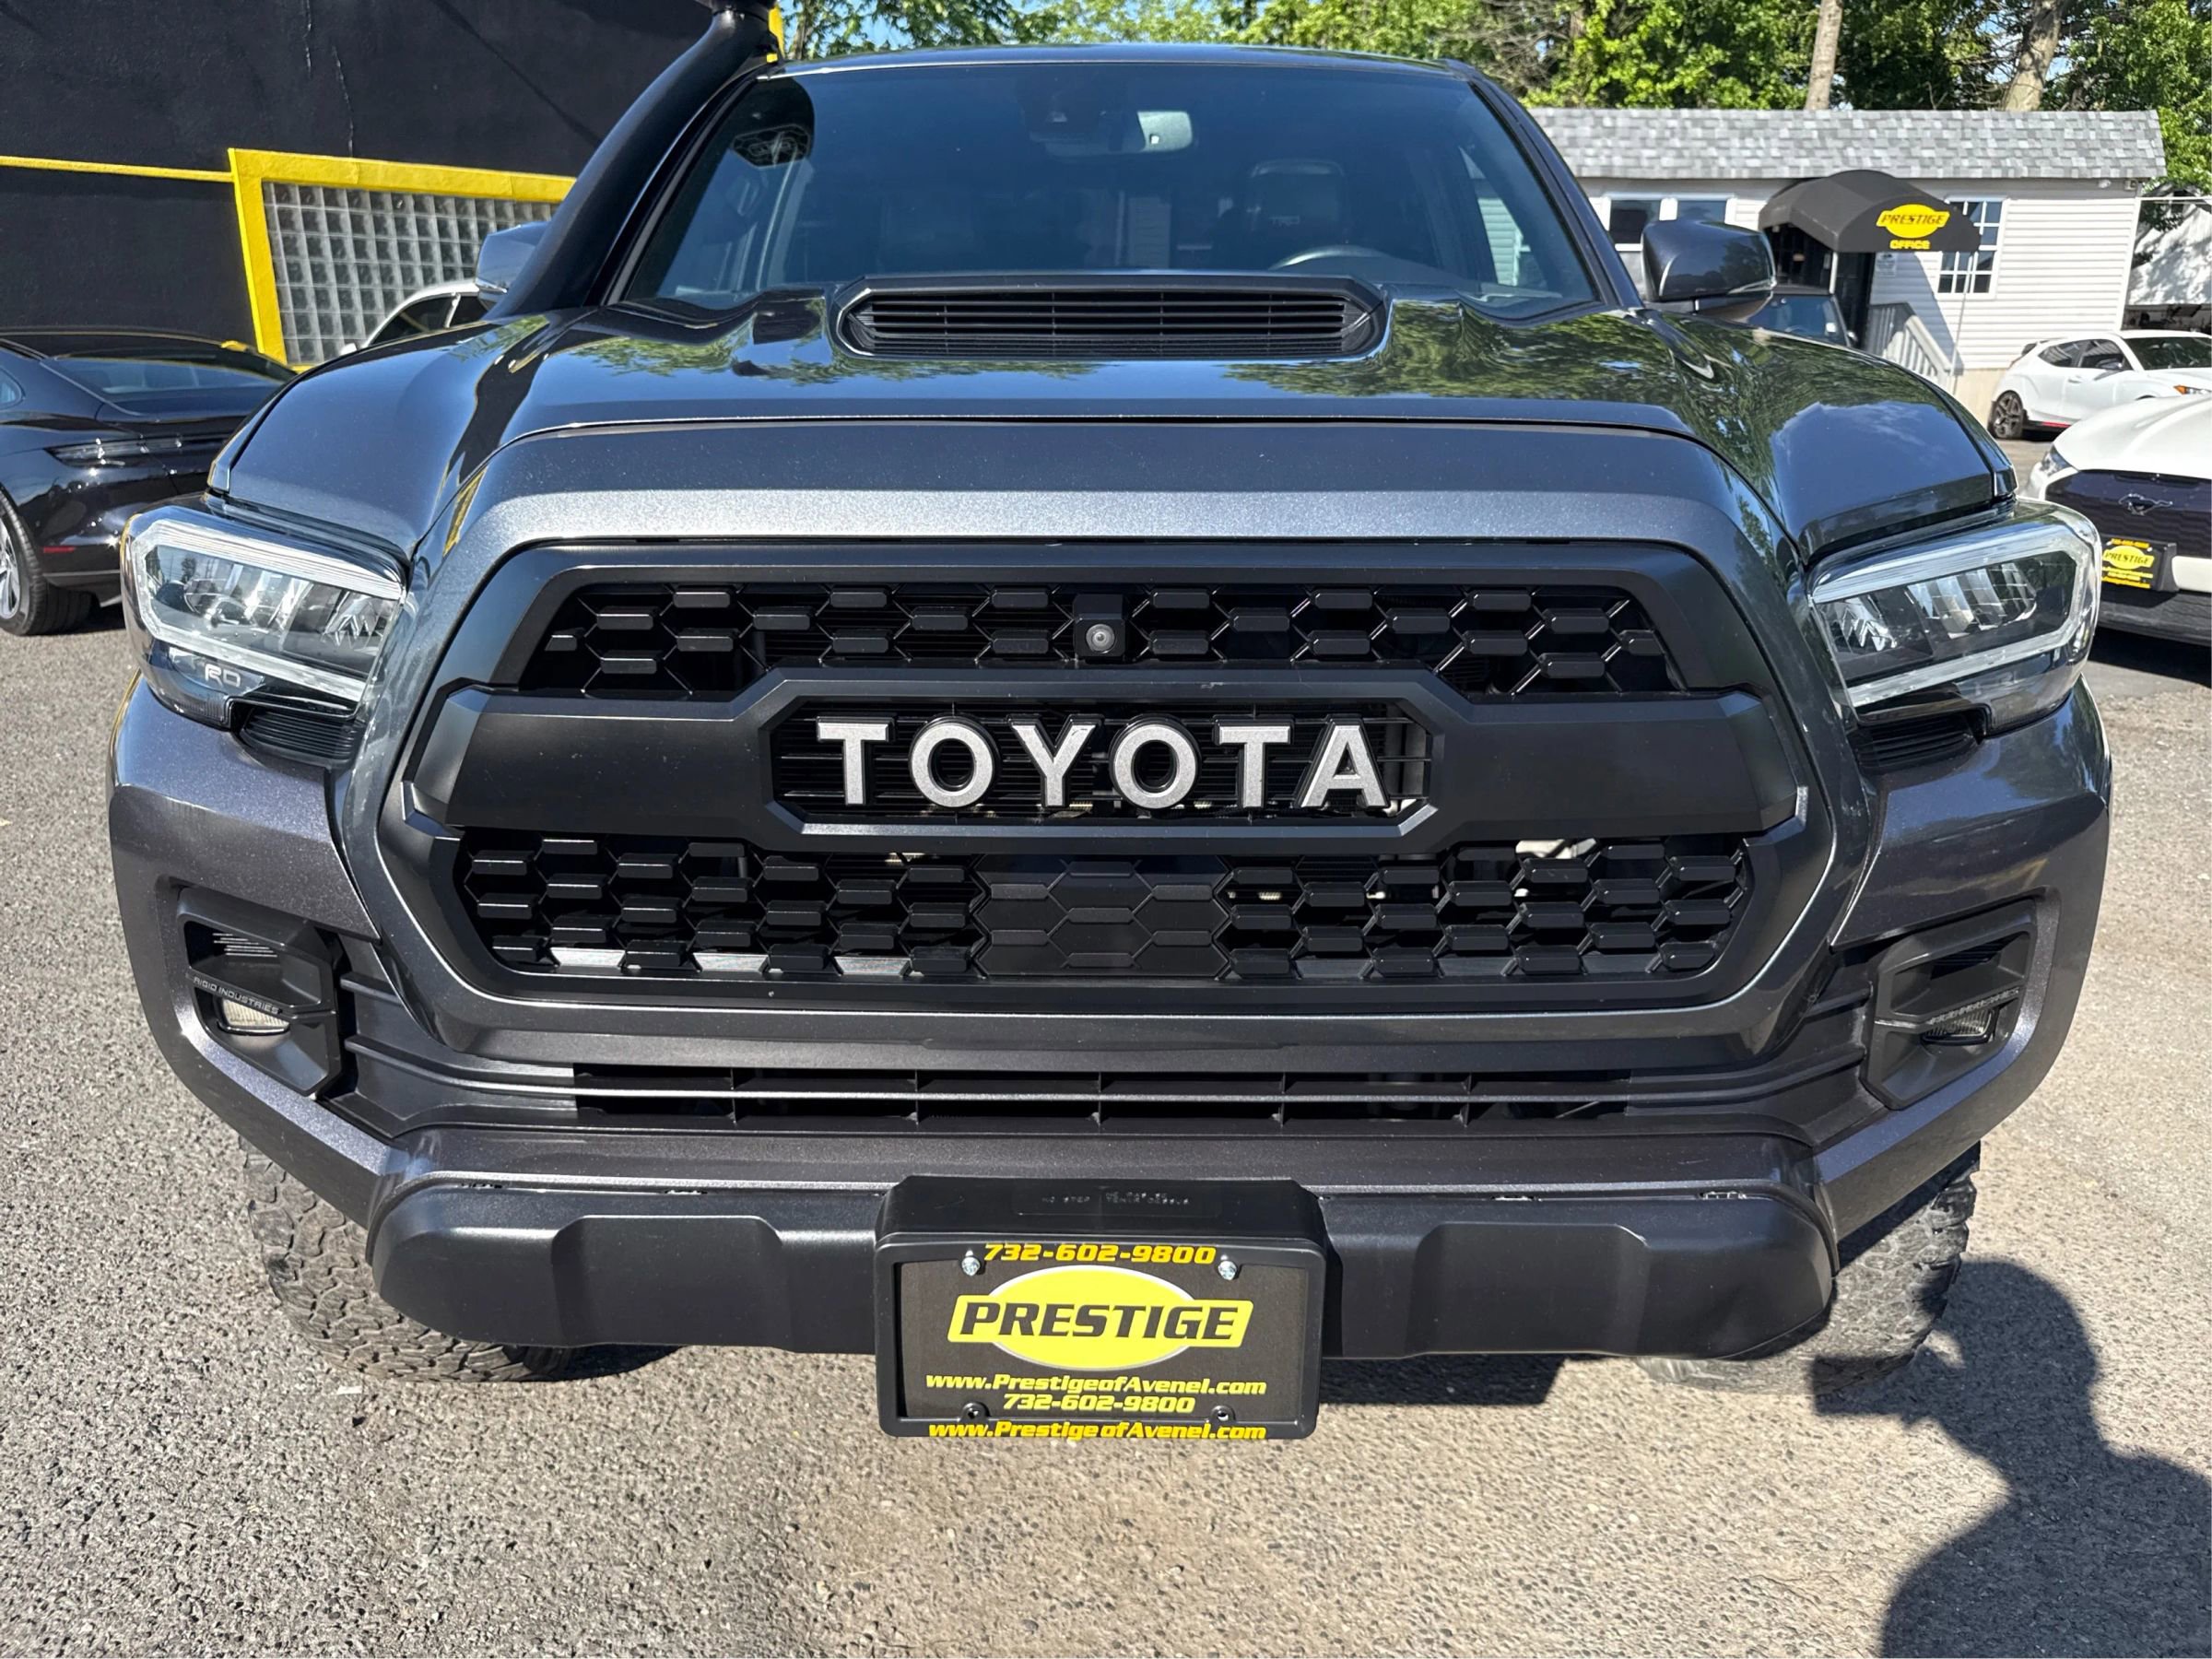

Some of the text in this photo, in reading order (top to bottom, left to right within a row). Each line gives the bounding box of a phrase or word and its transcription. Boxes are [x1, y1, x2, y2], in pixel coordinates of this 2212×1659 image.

[1881, 214, 1945, 226] PRESTIGE
[1889, 240, 1931, 250] OFFICE
[2105, 552, 2149, 564] PRESTIGE
[815, 717, 1391, 811] TOYOTA
[193, 976, 280, 1015] RIGID INDUSTRIES
[983, 1243, 1217, 1265] 732-602-9800
[959, 1300, 1239, 1340] PRESTIGE
[925, 1373, 1267, 1395] www.PrestigeofAvenel.com
[1003, 1393, 1196, 1413] 732-602-9800
[928, 1420, 1267, 1441] www.PrestigeofAvenel.com
